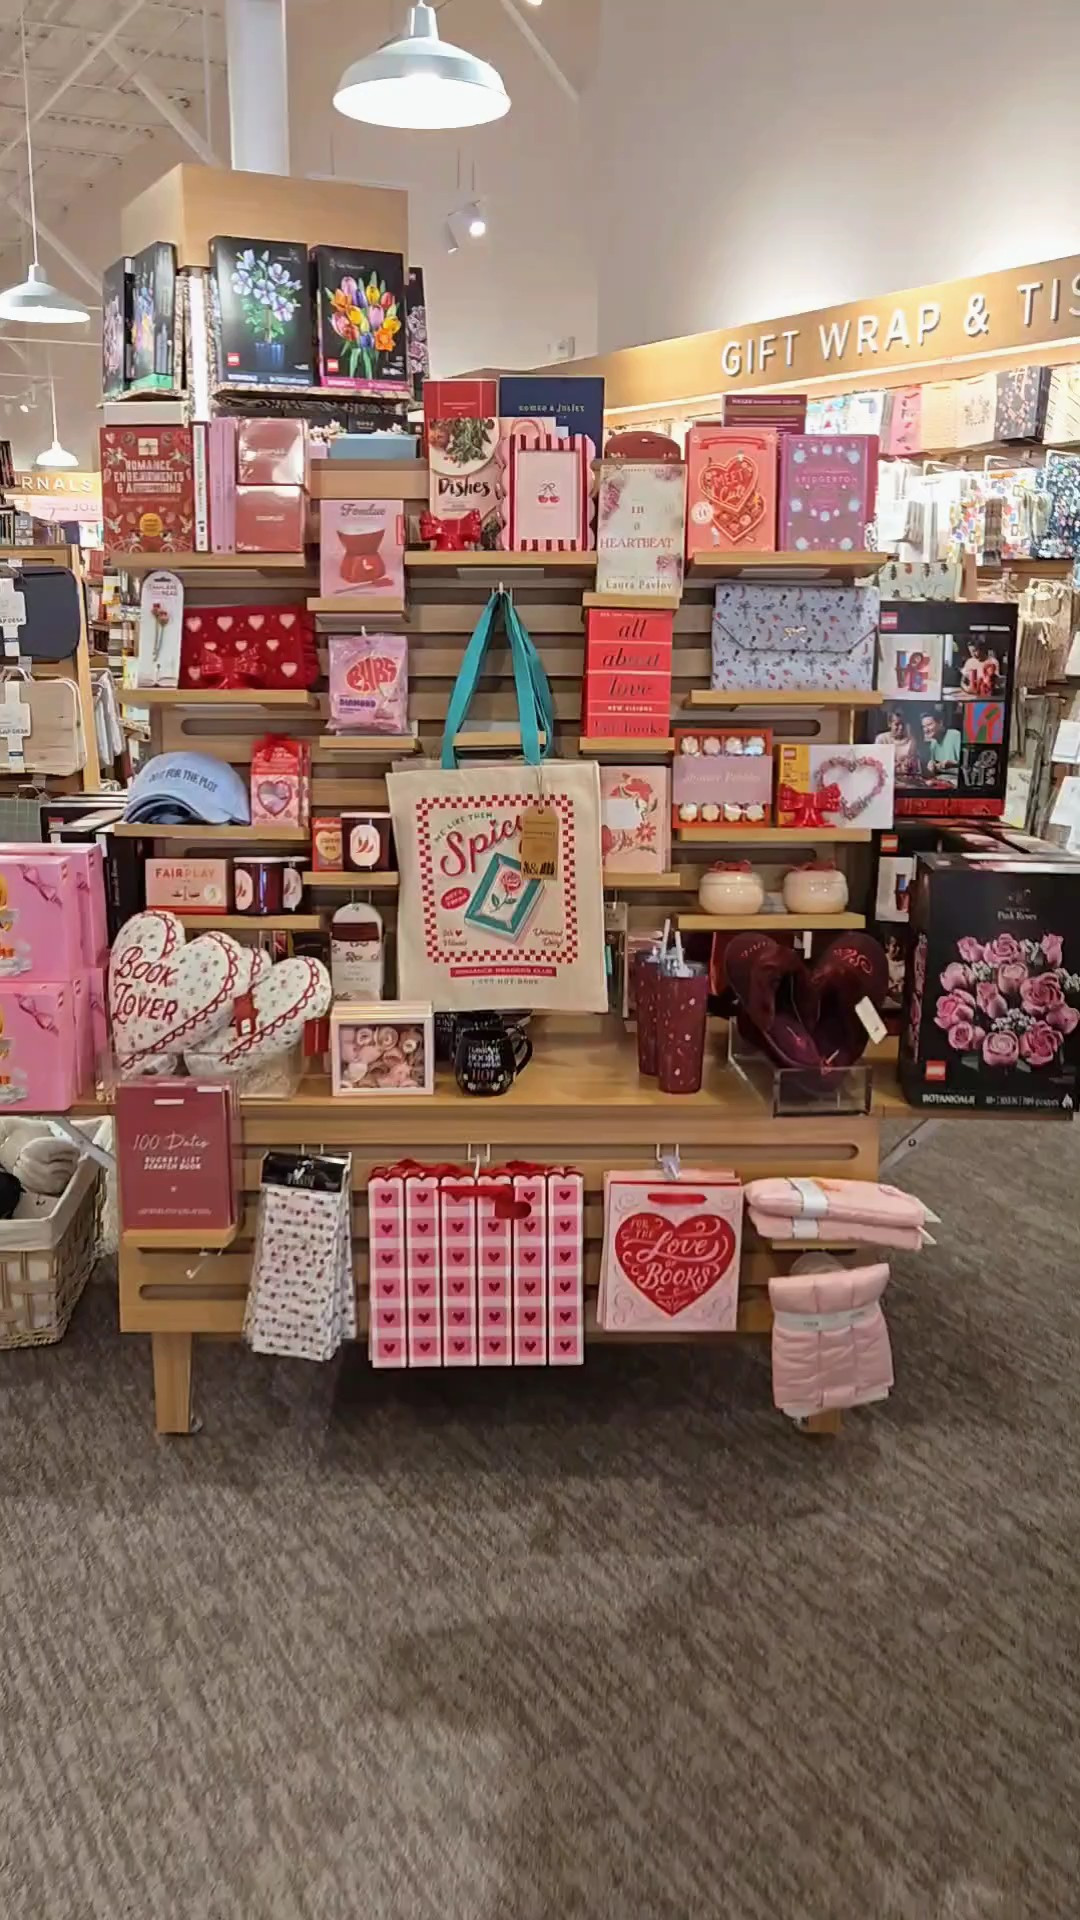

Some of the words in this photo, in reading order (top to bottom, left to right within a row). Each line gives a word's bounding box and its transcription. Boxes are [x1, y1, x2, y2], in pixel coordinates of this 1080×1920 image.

[721, 328, 802, 376] GIFT
[819, 304, 940, 360] WRAP
[962, 293, 991, 338] &
[14, 475, 93, 493] RNALS
[438, 474, 491, 497] Dishes
[713, 470, 745, 488] MEET
[600, 537, 675, 549] HEARTBEAT
[605, 579, 635, 590] Laura
[638, 579, 673, 590] Pavlov
[618, 618, 648, 638] all
[602, 647, 659, 667] about
[345, 656, 398, 692] BUBS
[609, 676, 652, 697] love
[183, 770, 201, 784] THE
[199, 776, 219, 793] PLOT
[468, 812, 493, 821] THEM
[440, 815, 523, 877] Spic
[133, 1134, 160, 1150] 100
[164, 1131, 209, 1150] Dates
[631, 1219, 649, 1230] FOR
[635, 1230, 653, 1239] THE
[637, 1230, 714, 1262] Love
[637, 1262, 712, 1293] BOOKS
